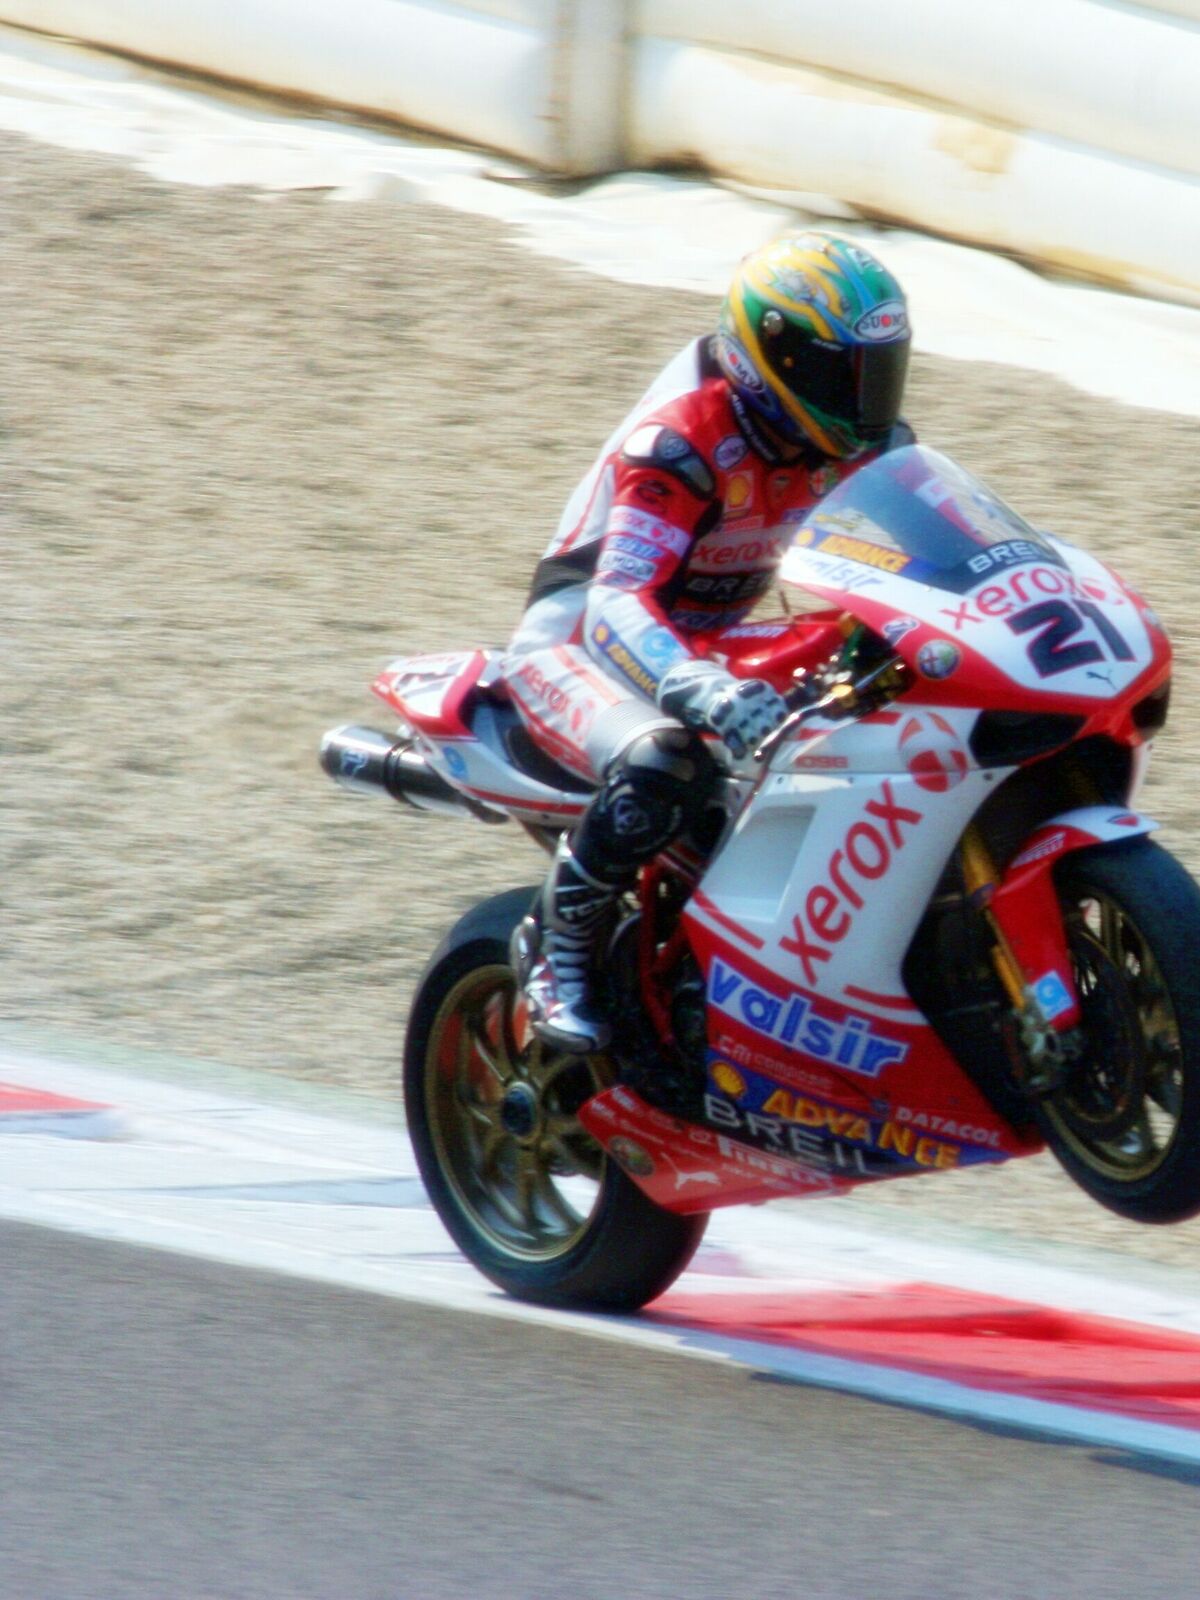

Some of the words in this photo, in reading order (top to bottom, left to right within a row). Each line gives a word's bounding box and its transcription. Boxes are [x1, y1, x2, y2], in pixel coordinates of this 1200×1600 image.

[694, 538, 781, 565] xerox
[817, 534, 911, 573] ADVANCE
[607, 644, 657, 696] ADVANC
[1004, 598, 1136, 680] 21
[779, 779, 924, 987] xerox
[709, 960, 907, 1072] valsir
[703, 1094, 888, 1177] BREIL
[762, 1089, 962, 1169] ADVANCE
[896, 1105, 1001, 1147] DATACOL
